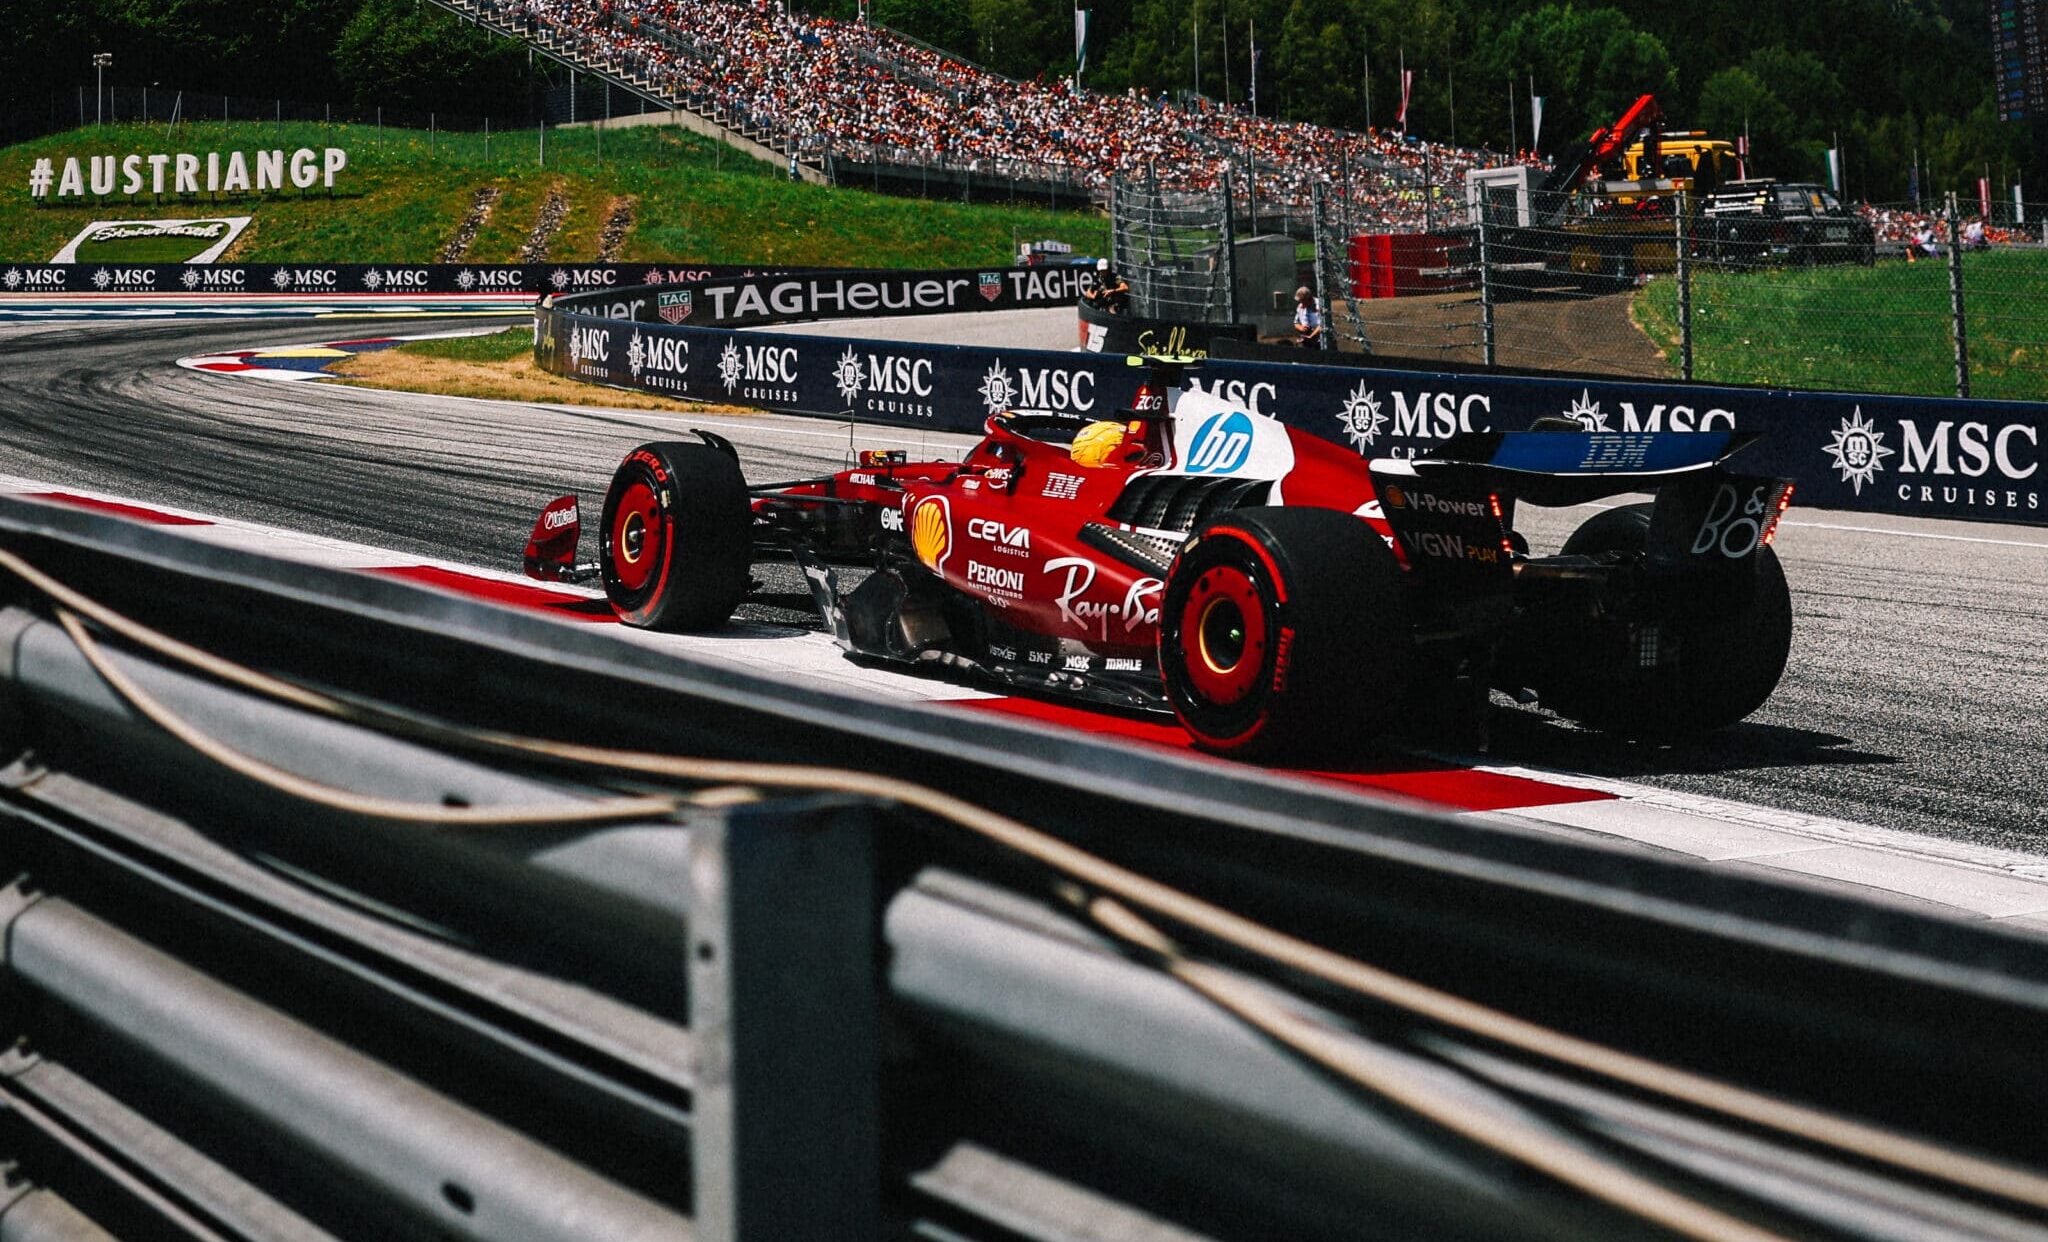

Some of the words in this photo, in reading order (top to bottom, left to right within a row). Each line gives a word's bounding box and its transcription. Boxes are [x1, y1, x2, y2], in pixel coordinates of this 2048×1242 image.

[29, 147, 348, 198] #AUSTRIANGP
[24, 269, 66, 285] MSC
[113, 269, 156, 285] MSC
[203, 269, 245, 285] MSC
[294, 269, 337, 285] MSC
[385, 270, 428, 286] MSC
[479, 270, 522, 286] MSC
[572, 269, 617, 286] MSC
[661, 292, 689, 305] TAG
[660, 303, 690, 321] HEUER
[581, 327, 610, 362] MSC
[646, 336, 689, 374] MSC
[744, 345, 798, 384] MSC
[580, 363, 609, 378] CRUISES
[867, 353, 933, 397] MSC
[645, 375, 688, 392] CRUISES
[1018, 367, 1095, 412] MSC
[743, 387, 798, 402] CRUISES
[867, 399, 933, 418] CRUISES
[1391, 390, 1491, 439] MSC
[1619, 401, 1736, 432] MSC
[1187, 411, 1250, 474] hp
[1579, 435, 1654, 468] IBM
[1897, 419, 2039, 479] MSC
[632, 449, 669, 483] ZERO
[849, 473, 876, 487] RICHAR
[1041, 472, 1086, 500] IBM
[1405, 491, 1486, 517] V-Power
[1897, 484, 2039, 509] CRUISES
[993, 545, 1030, 558] LOGISTICS
[1403, 530, 1464, 559] VGW
[1466, 545, 1498, 563] PLAY
[967, 559, 1025, 592] PERONI
[967, 581, 992, 593] NASTRO
[992, 588, 1023, 600] AZZURRO
[1043, 556, 1164, 641] Ray-Ba
[1029, 650, 1053, 664] SKF
[1064, 655, 1090, 671] NGK
[1105, 657, 1143, 671] MAHLE
